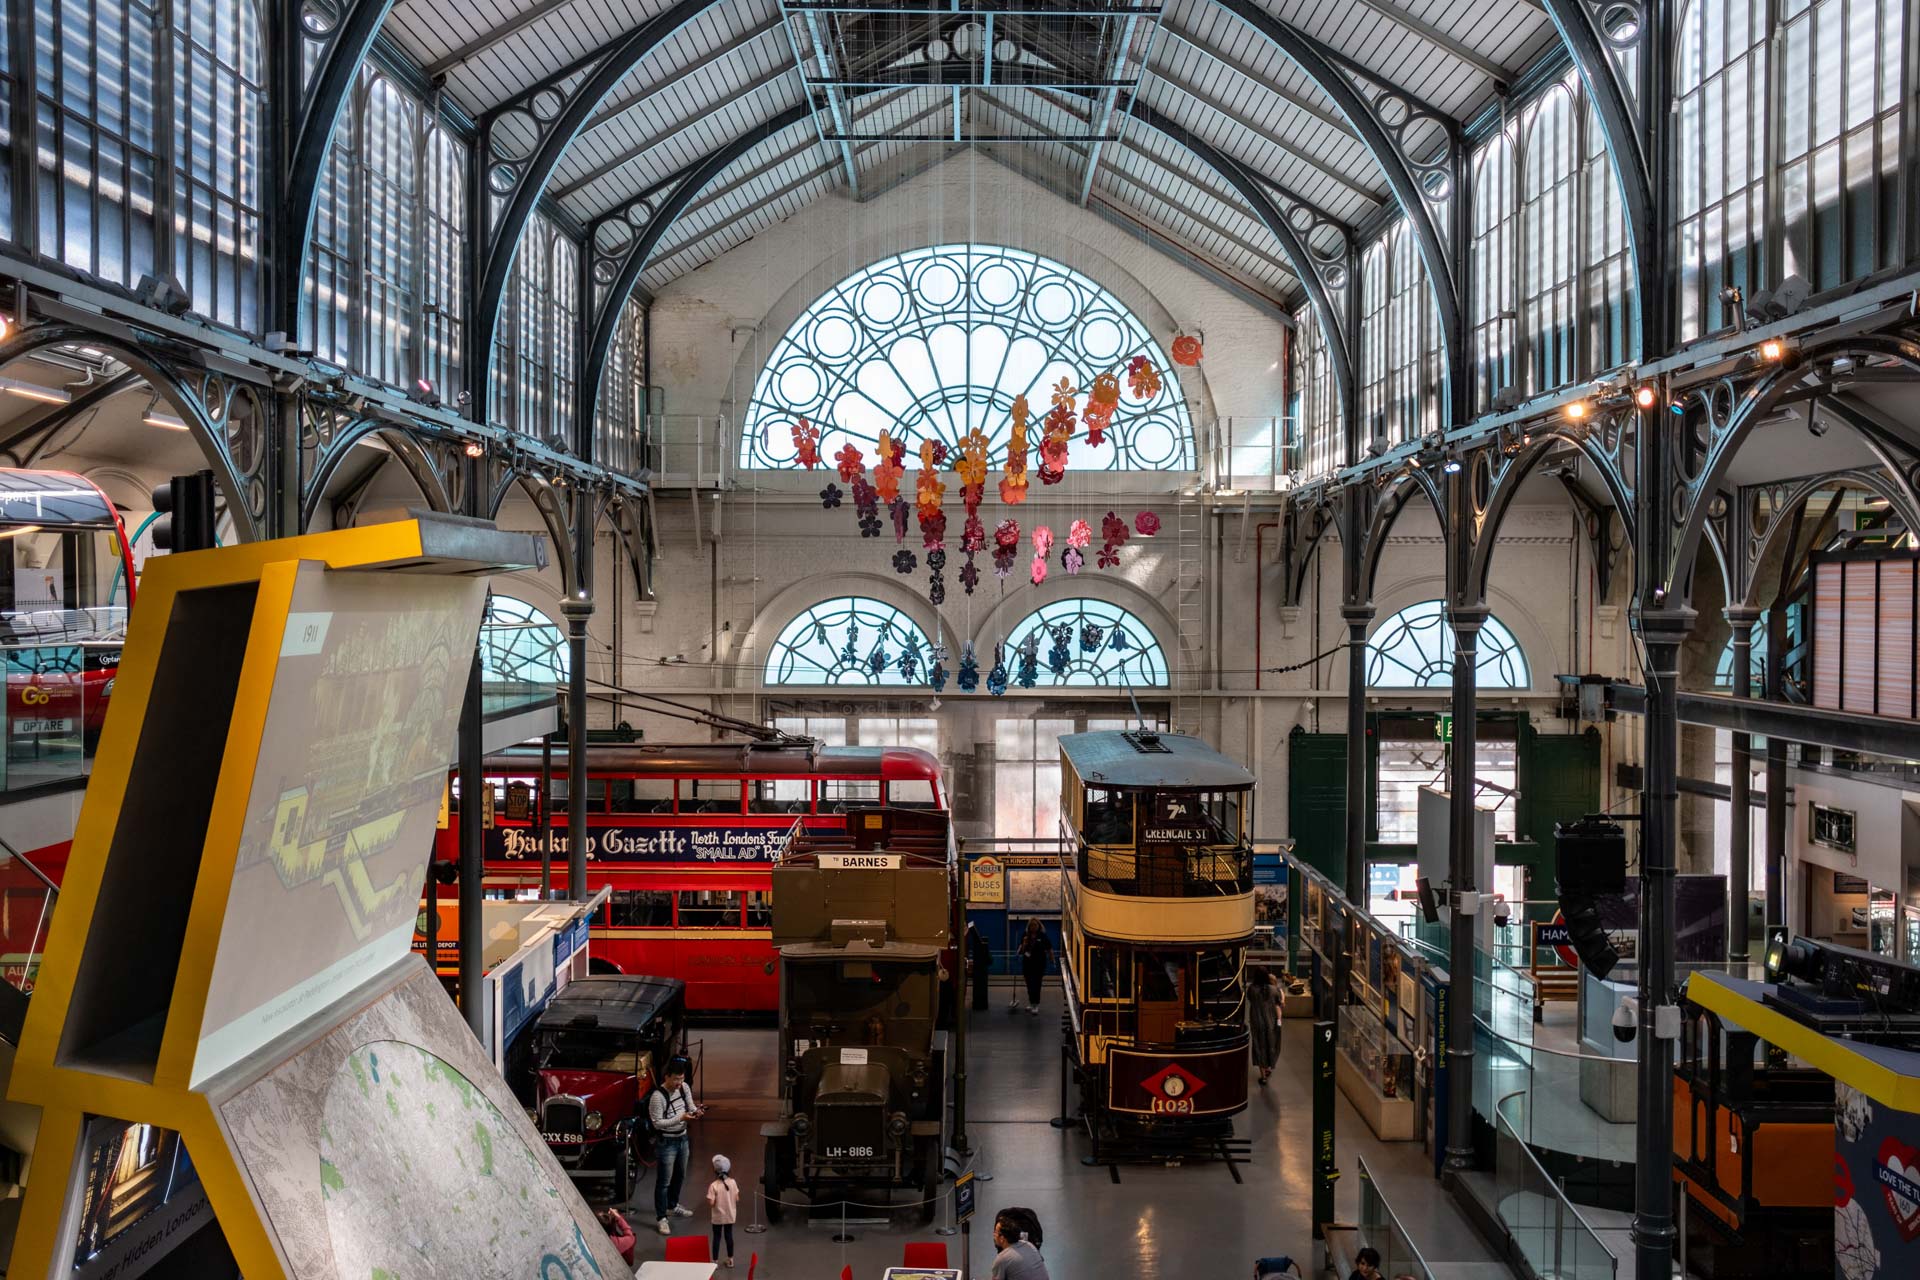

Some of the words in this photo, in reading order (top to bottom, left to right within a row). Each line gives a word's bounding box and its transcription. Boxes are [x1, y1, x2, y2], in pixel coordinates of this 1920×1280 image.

[302, 624, 319, 643] 1911
[22, 686, 49, 705] Go
[23, 720, 64, 732] OPTARE
[509, 795, 527, 807] STOP
[1167, 804, 1187, 820] 7A
[602, 828, 687, 854] Gazette
[690, 831, 720, 845] North
[722, 830, 765, 845] London's
[738, 845, 761, 859] AD"
[842, 857, 888, 867] BARNES
[973, 880, 1001, 889] BUSES
[1774, 931, 1783, 943] 6
[1324, 1029, 1332, 1042] 9
[1156, 1099, 1189, 1113] 102
[563, 1133, 584, 1143] 598
[1879, 1167, 1897, 1188] LOVE
[1898, 1179, 1912, 1197] THE
[1900, 1198, 1911, 1214] 160
[122, 1230, 163, 1272] Hidden
[166, 1197, 205, 1238] London
